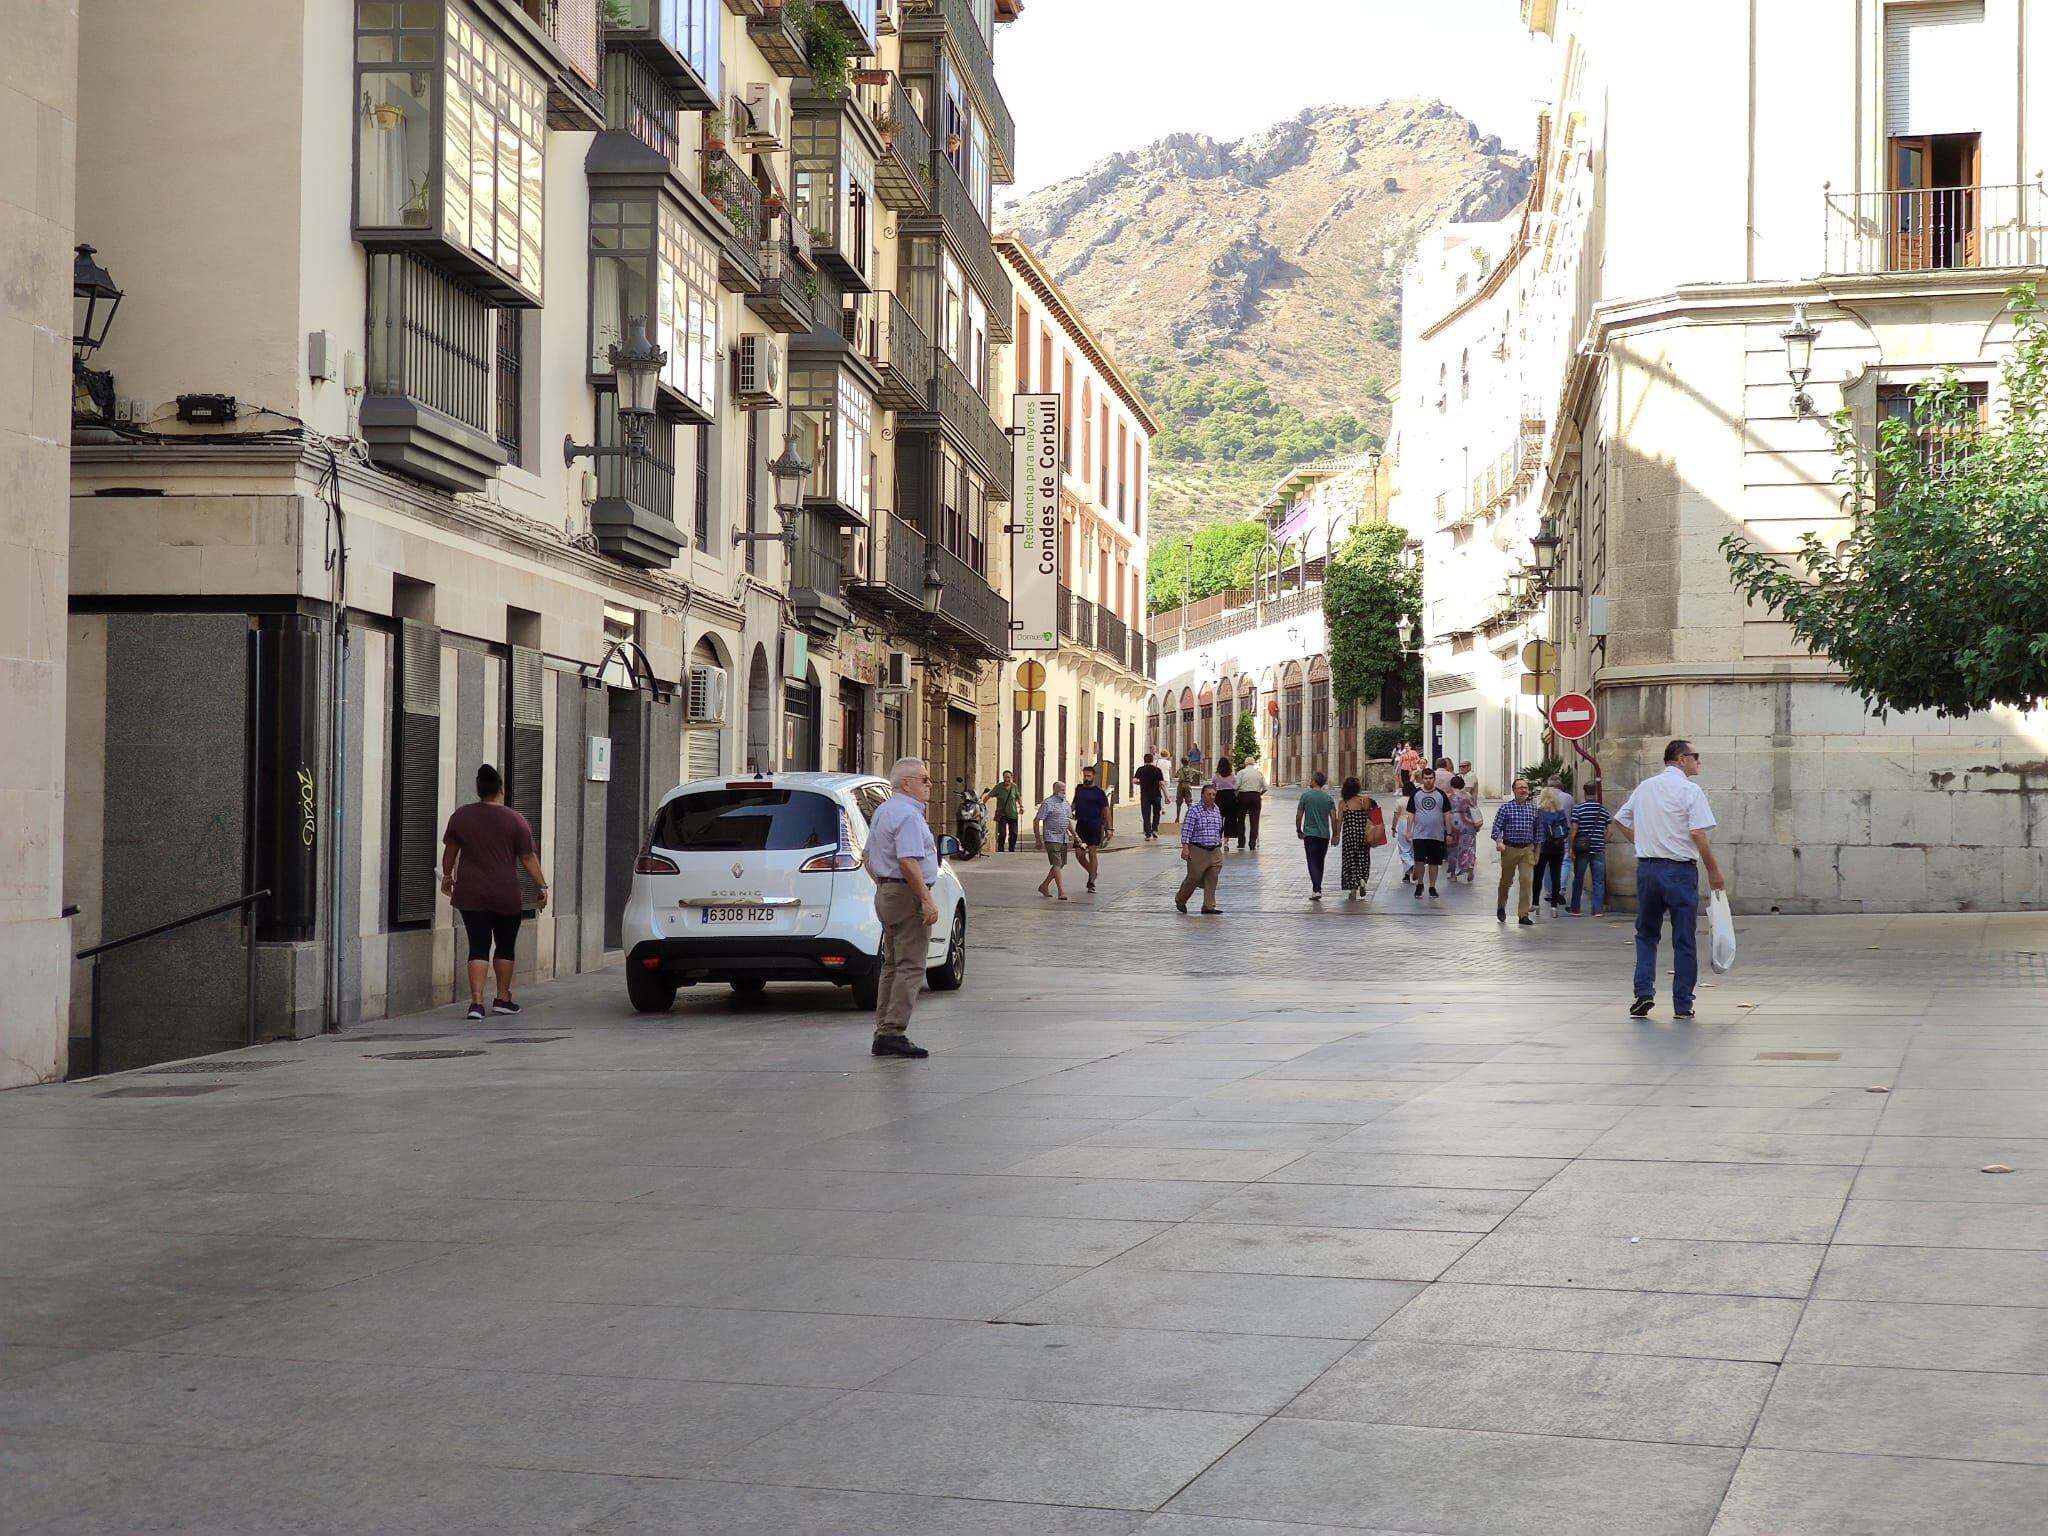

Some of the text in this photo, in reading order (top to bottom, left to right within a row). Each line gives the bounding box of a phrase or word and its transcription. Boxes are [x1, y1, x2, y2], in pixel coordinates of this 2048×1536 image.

[1023, 401, 1037, 549] Residencia para mayores
[1038, 401, 1056, 575] Condes de Corbull
[709, 908, 743, 921] 6308
[748, 908, 774, 921] HZB
